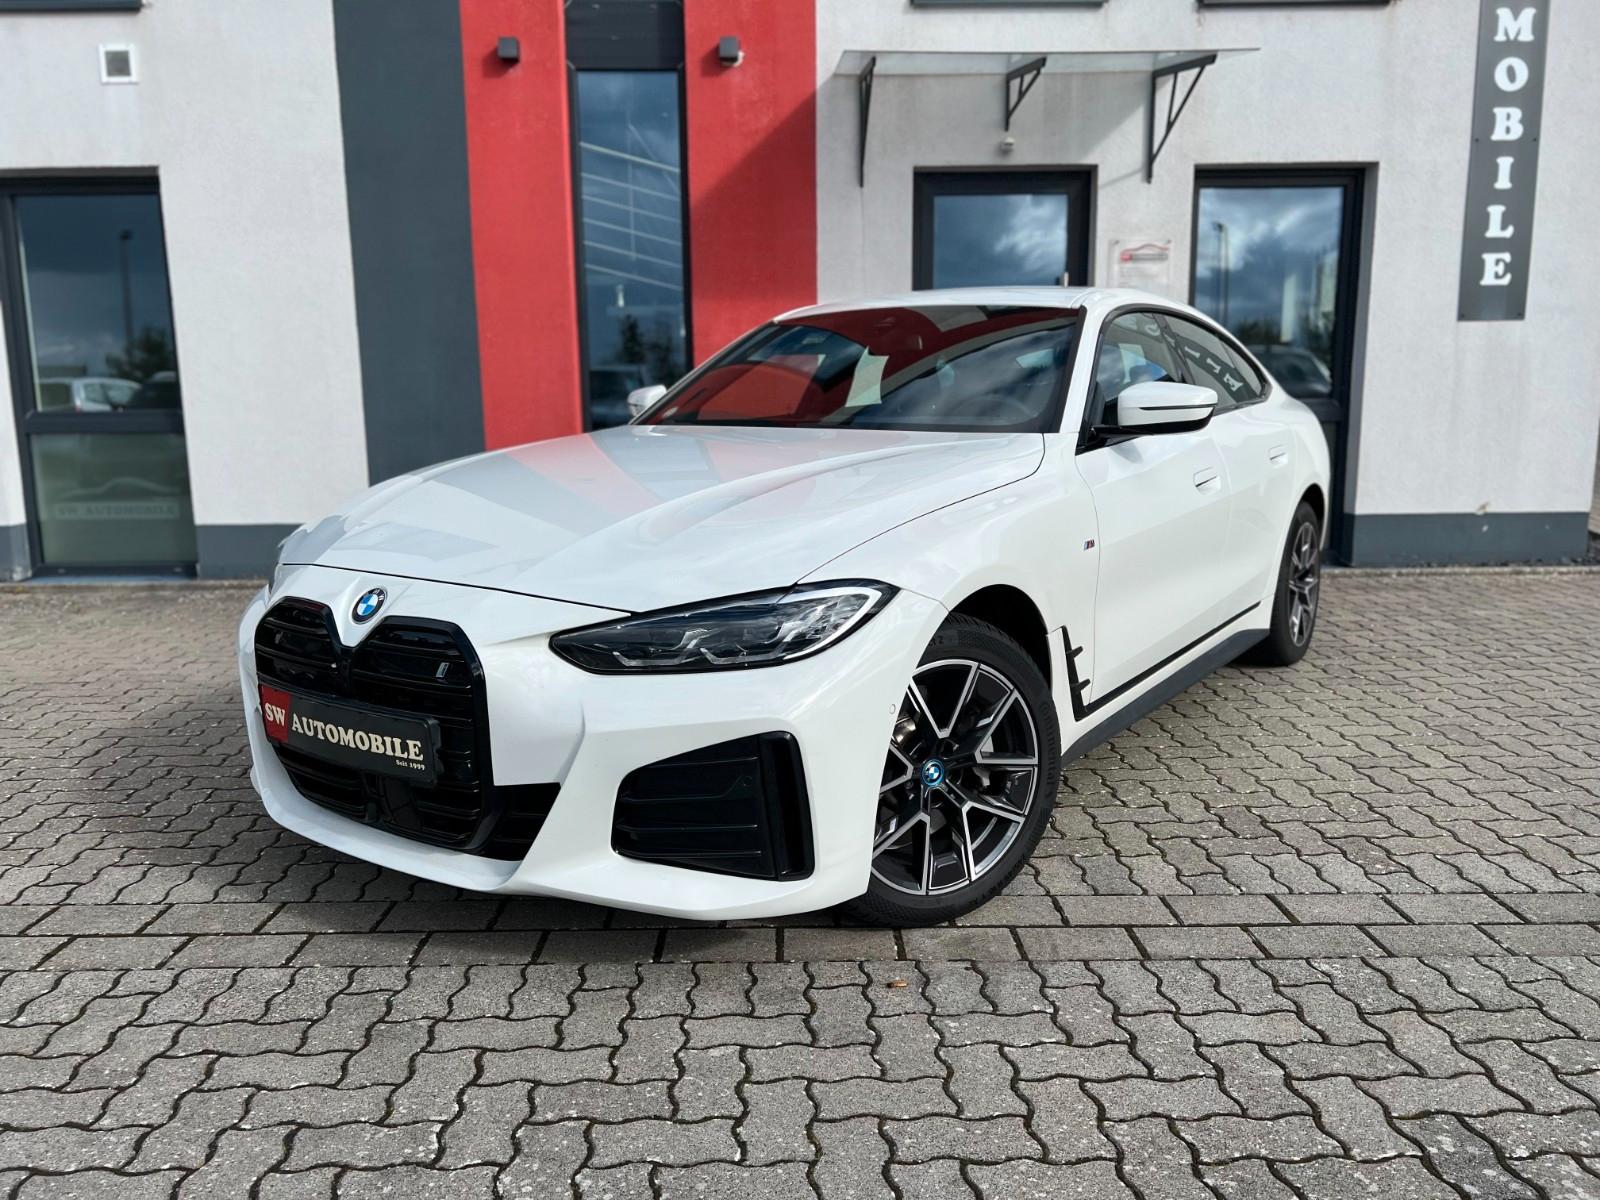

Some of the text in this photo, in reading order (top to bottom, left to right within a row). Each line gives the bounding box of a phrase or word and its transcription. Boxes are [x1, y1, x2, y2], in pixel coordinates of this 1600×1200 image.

[1480, 7, 1537, 286] MOBILE
[264, 702, 424, 761] SW AUTOMOBILE
[395, 759, 425, 771] Seit 1999
